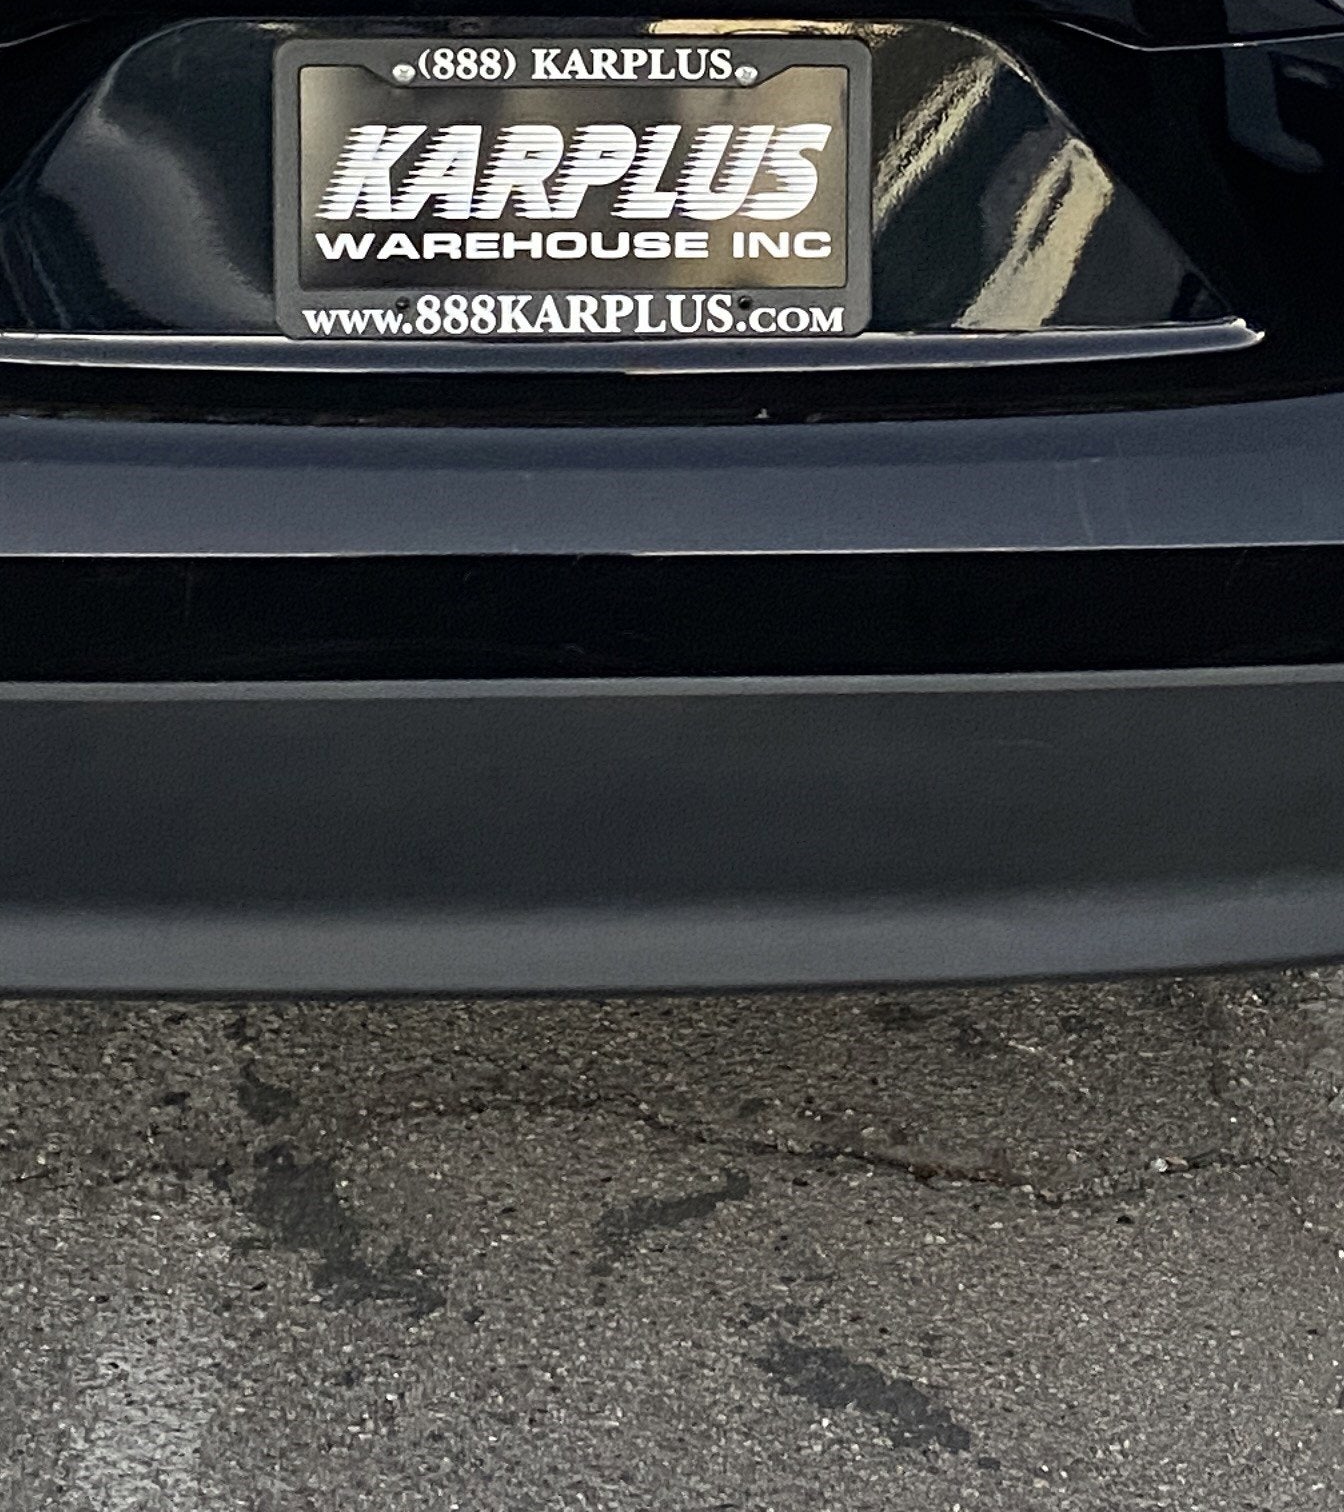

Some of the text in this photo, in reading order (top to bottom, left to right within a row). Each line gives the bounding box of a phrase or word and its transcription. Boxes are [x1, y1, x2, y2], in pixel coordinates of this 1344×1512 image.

[417, 48, 732, 82] (888) KARPLUS
[314, 124, 832, 220] KARPLUS
[315, 231, 832, 260] WAREHOUSE INC
